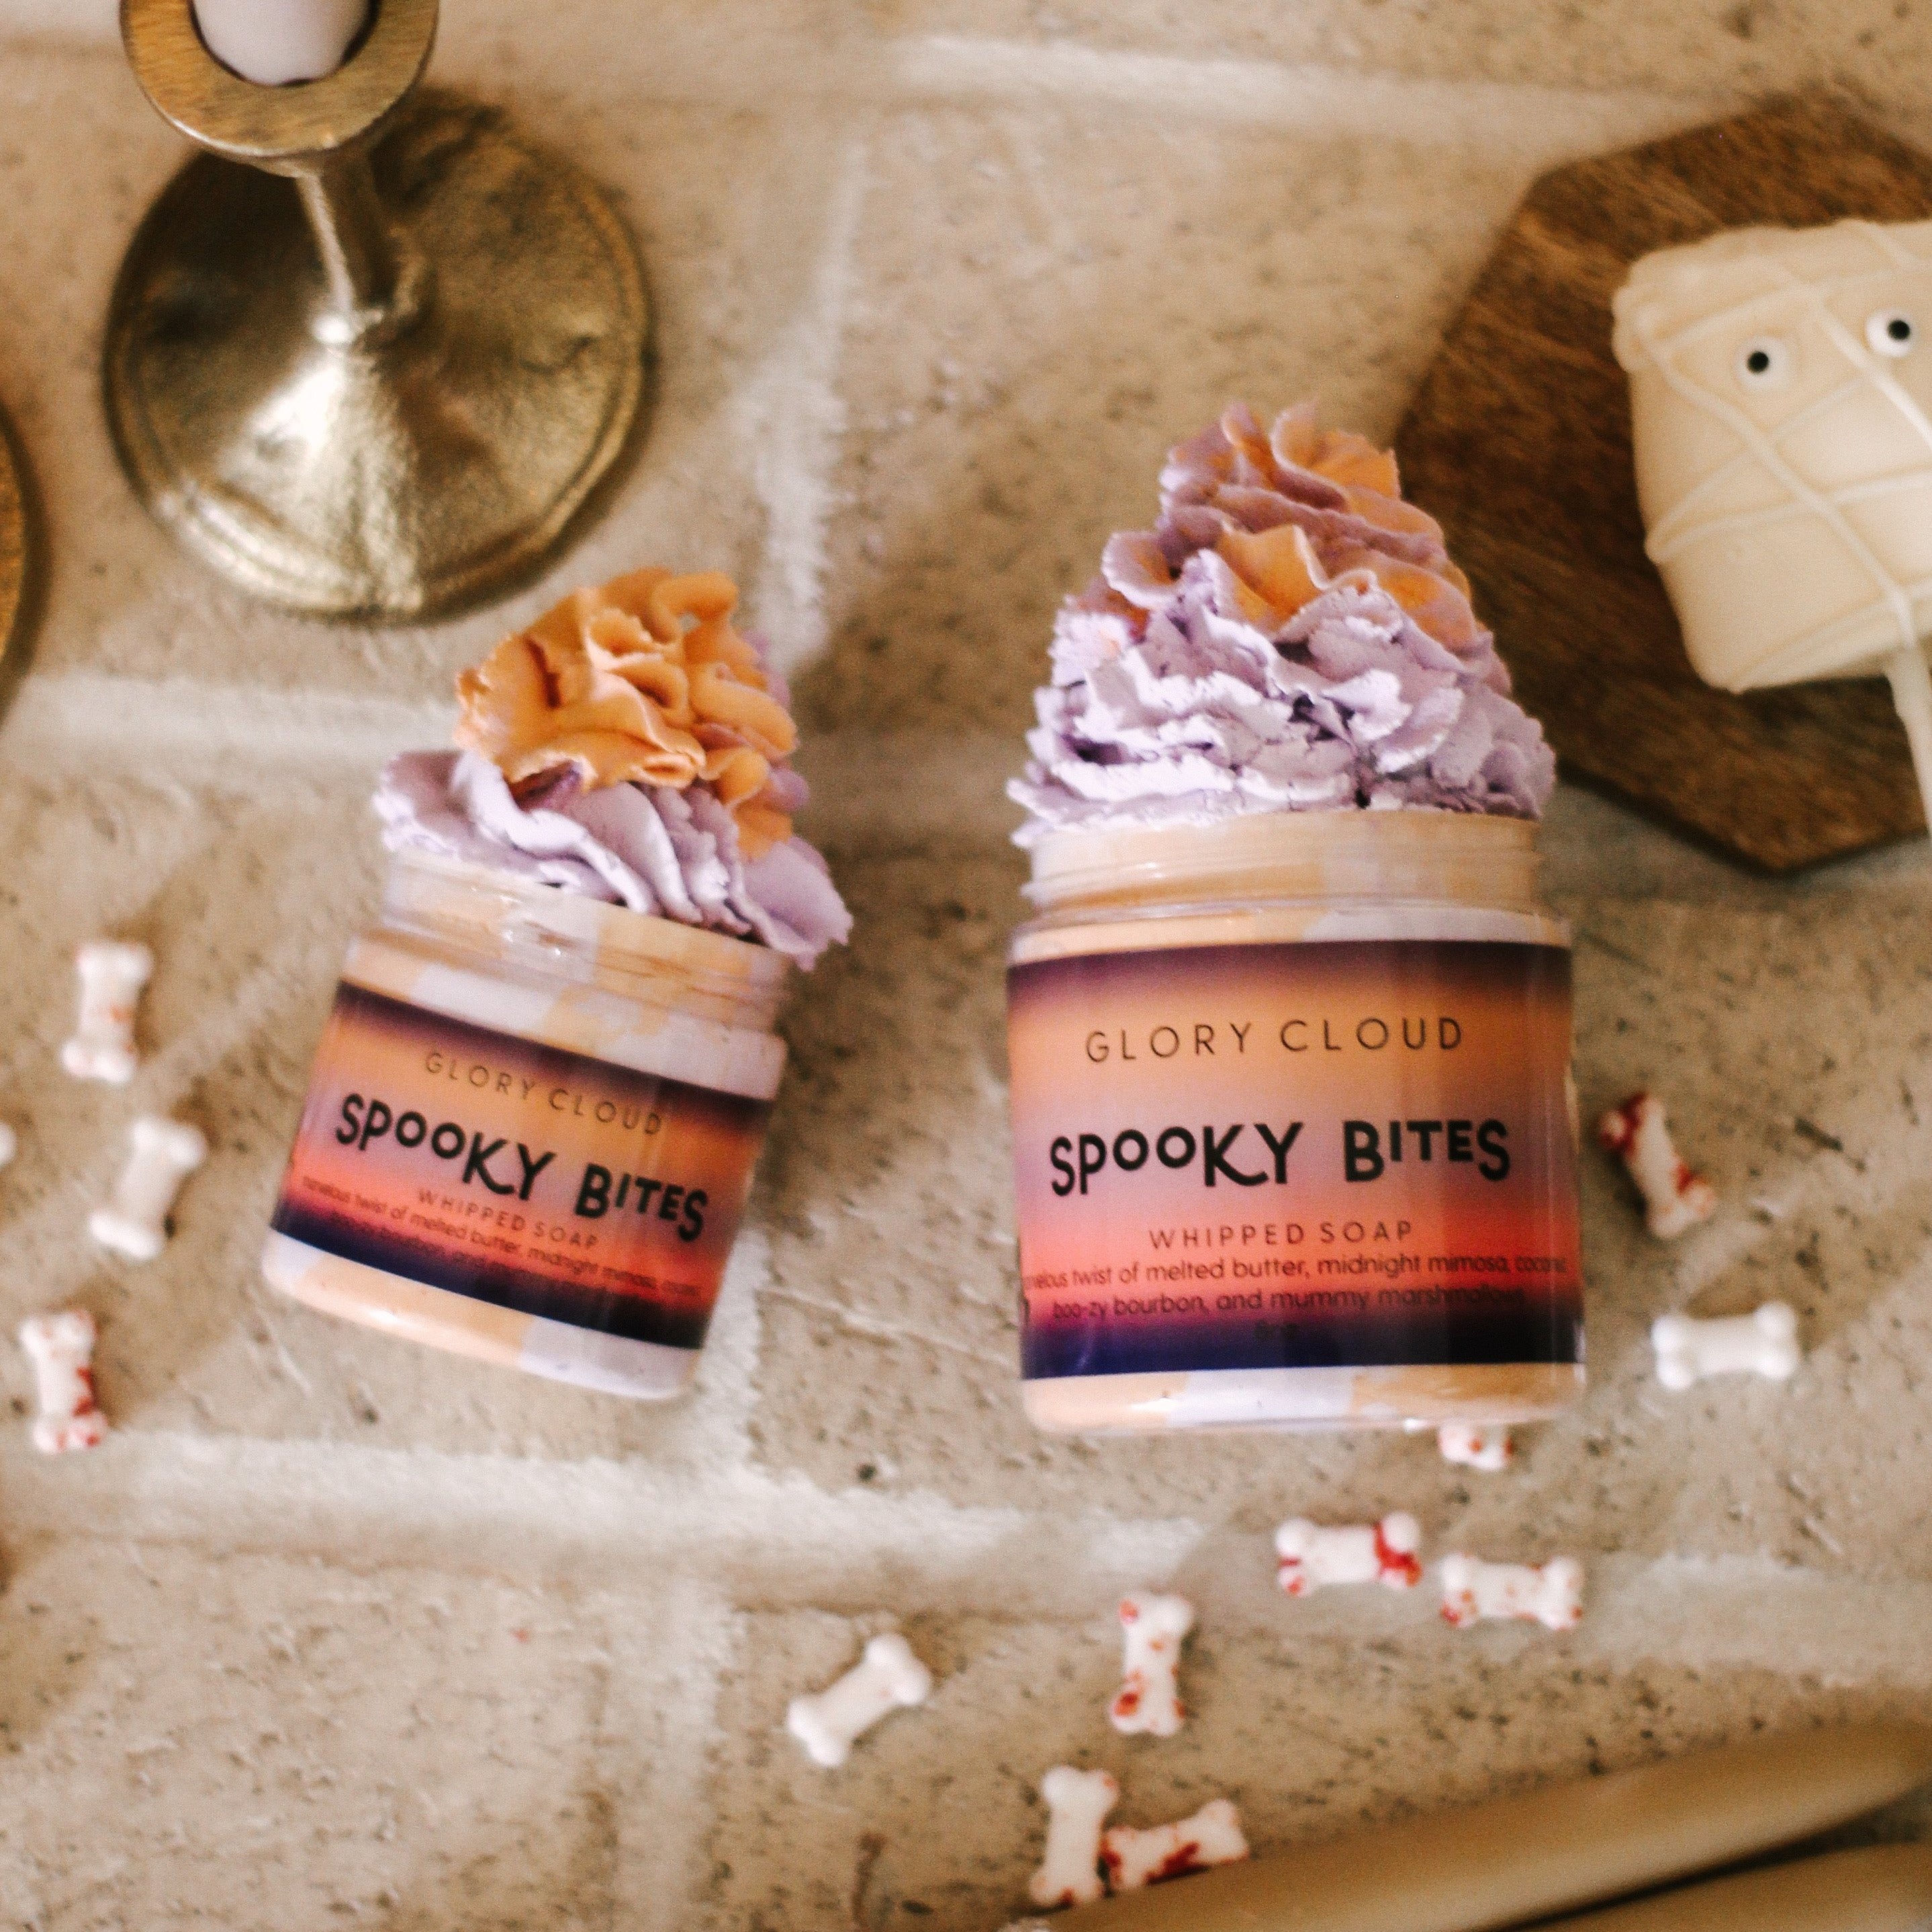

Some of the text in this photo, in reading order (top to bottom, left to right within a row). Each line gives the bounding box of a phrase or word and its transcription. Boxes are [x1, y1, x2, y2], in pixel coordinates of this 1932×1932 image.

[1086, 1017, 1463, 1062] GLORY CLOUD
[425, 1051, 664, 1136] GLORY CLOUD
[336, 1093, 709, 1242] SPOOKY BITES
[1049, 1118, 1511, 1197] SPOOKY BITES
[418, 1188, 526, 1232] WHIPPED
[533, 1220, 599, 1250] SOAP
[1149, 1220, 1413, 1250] WHIPPED SOAP
[1072, 1264, 1112, 1285] twist
[1119, 1260, 1139, 1284] of
[1146, 1257, 1224, 1282] melted
[1234, 1256, 1310, 1280] butter,
[1318, 1252, 1420, 1279] midnight
[1113, 1293, 1209, 1317] bourbon,
[1216, 1288, 1262, 1311] and
[1271, 1289, 1370, 1312] mummy
